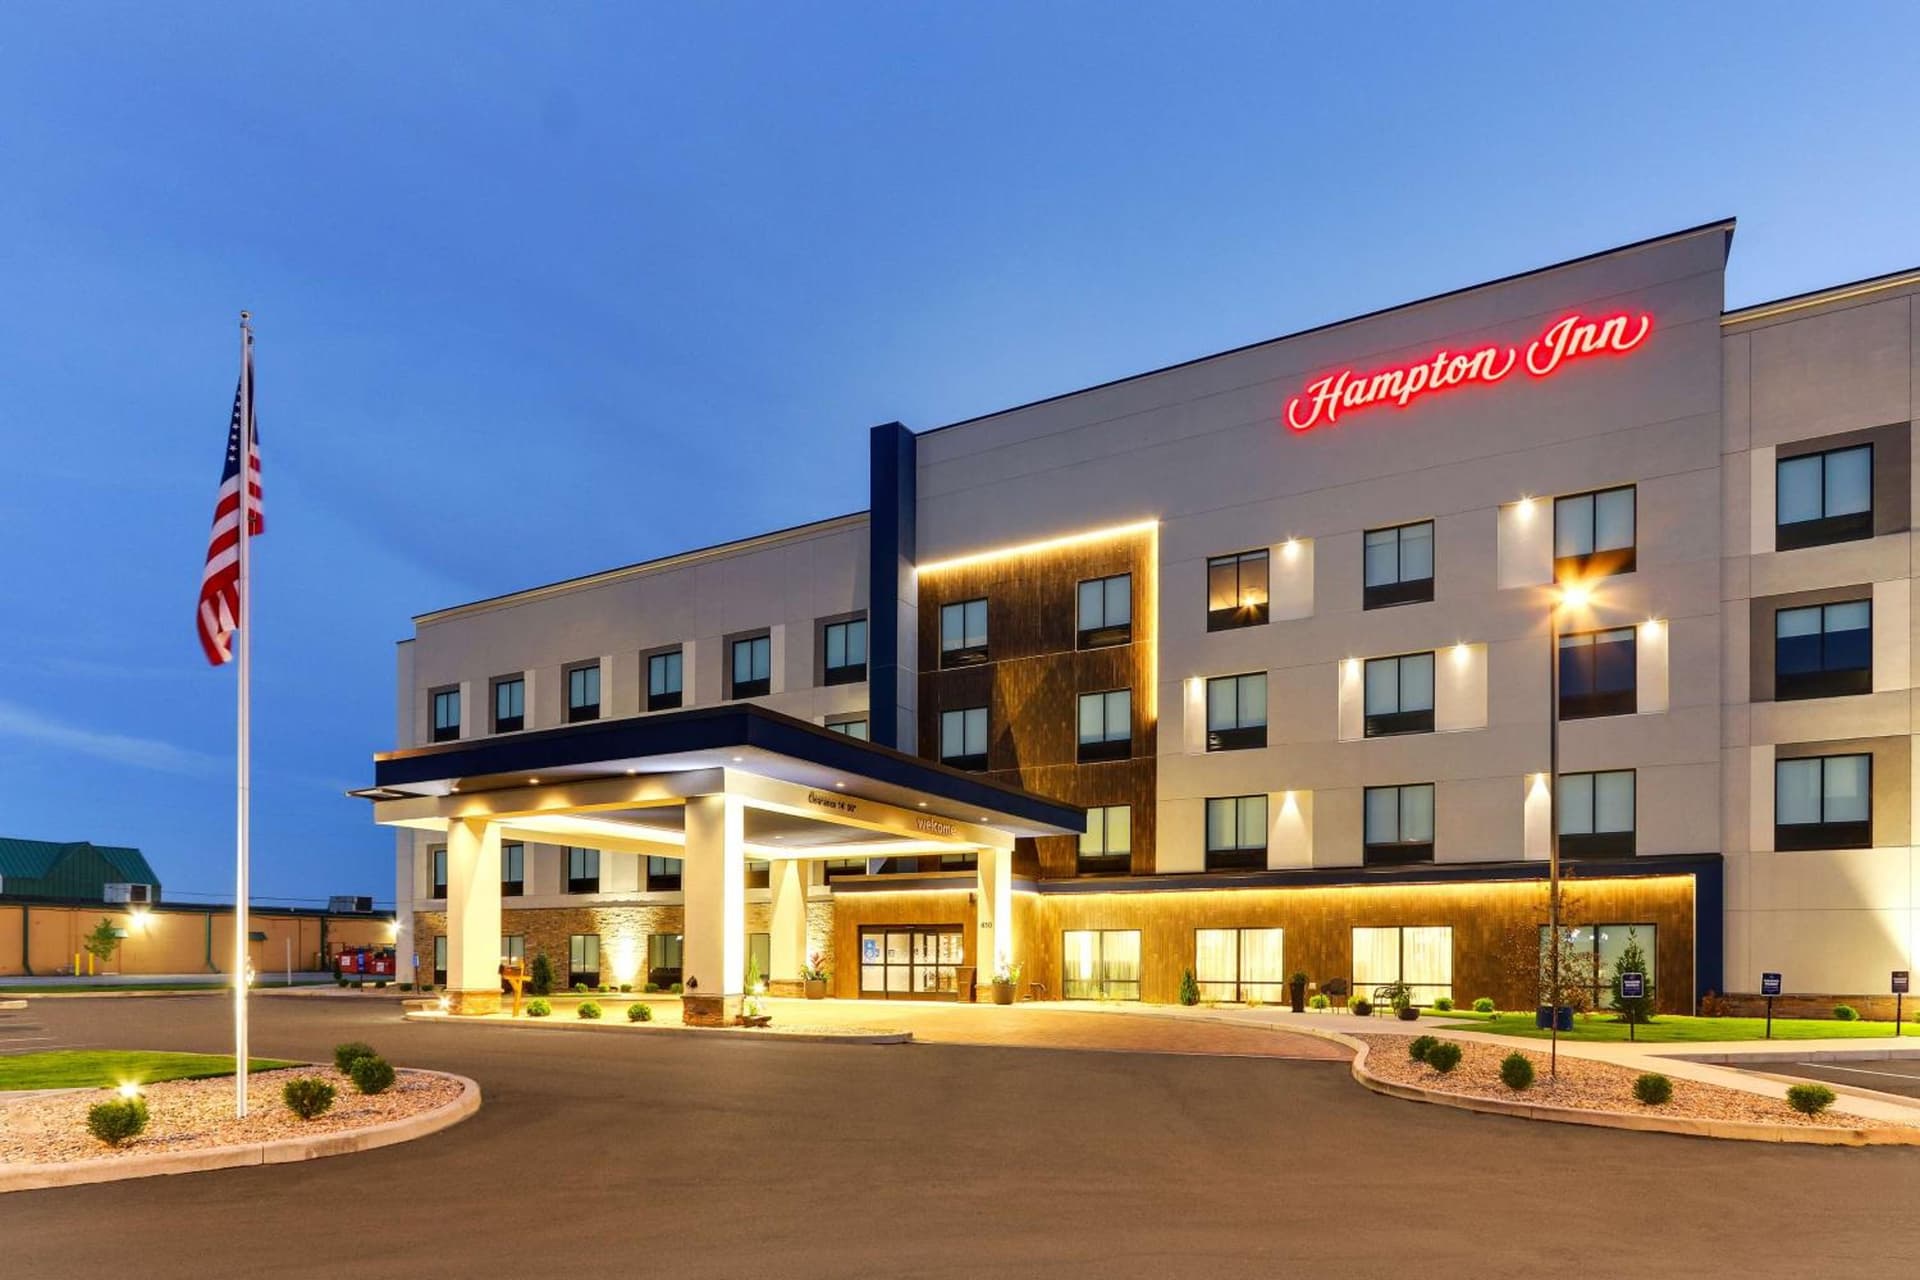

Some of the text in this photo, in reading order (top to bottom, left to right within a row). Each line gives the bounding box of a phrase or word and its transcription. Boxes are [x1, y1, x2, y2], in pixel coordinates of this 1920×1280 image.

[1287, 315, 1650, 429] Hampton Inn
[916, 817, 957, 836] welcome
